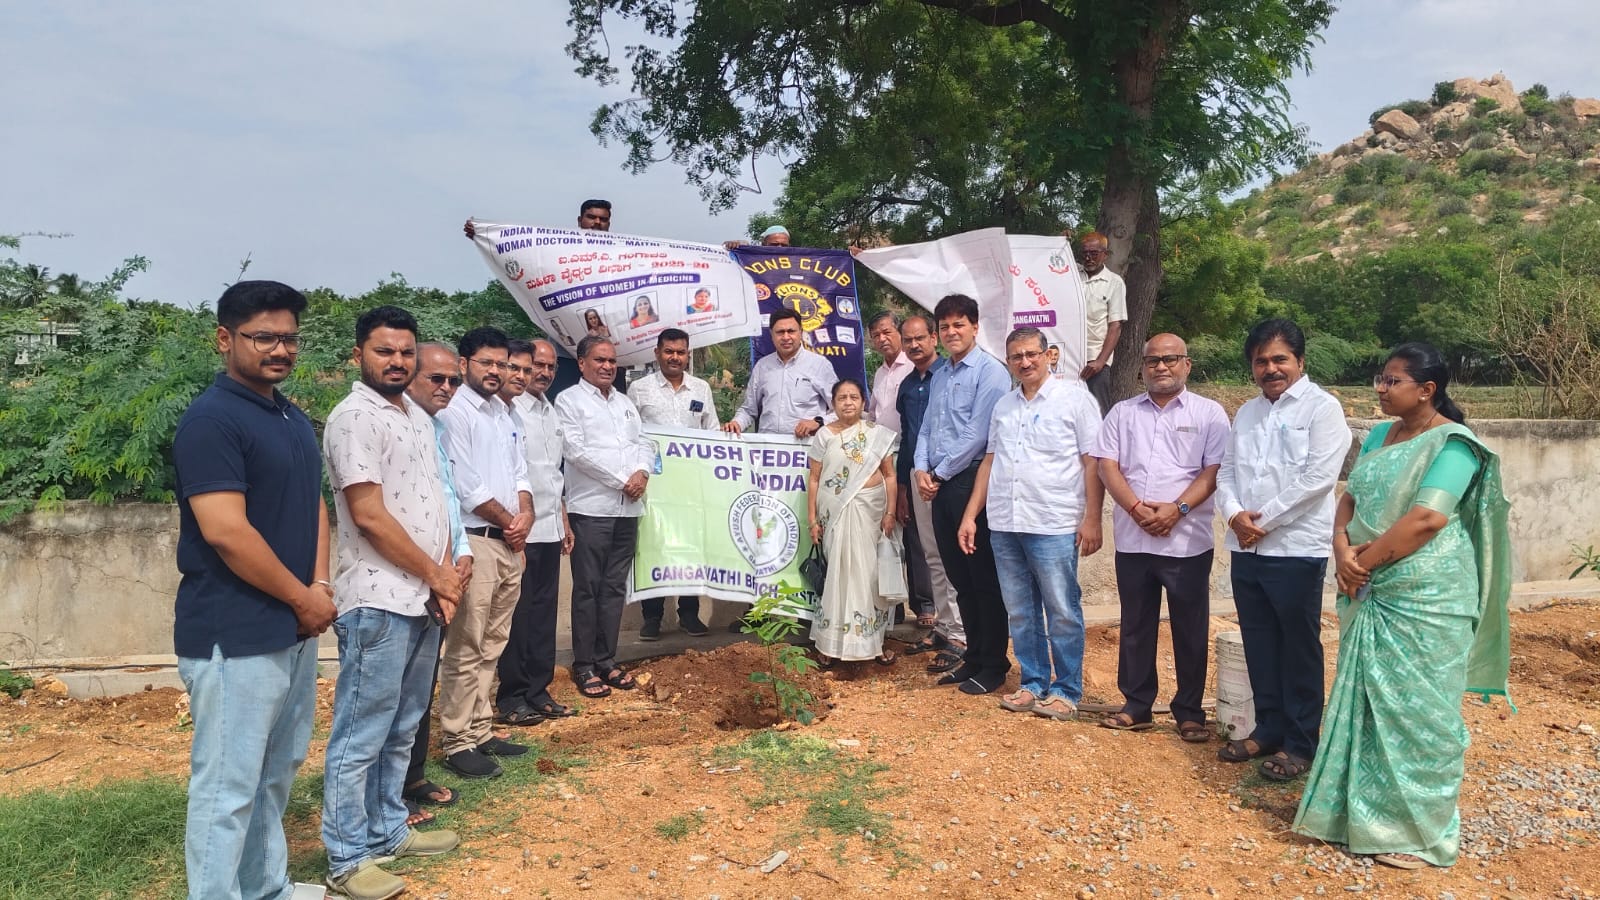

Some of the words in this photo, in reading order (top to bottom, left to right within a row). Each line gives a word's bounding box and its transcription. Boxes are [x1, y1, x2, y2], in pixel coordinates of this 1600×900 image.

[500, 227, 533, 238] INDIAN
[496, 238, 532, 255] WOMAN
[535, 237, 583, 246] DOCTORS
[744, 257, 792, 275] IONS
[800, 258, 851, 287] CLUB
[543, 298, 557, 308] THE
[556, 291, 583, 304] VISION
[585, 286, 598, 296] OF
[599, 280, 636, 294] WOMEN
[779, 285, 817, 299] LIONS
[666, 442, 744, 462] AYUSH
[714, 465, 743, 481] OF
[750, 469, 807, 492] INDIA
[732, 511, 744, 544] AYUSH
[780, 508, 793, 520] OF
[652, 565, 741, 586] GANGAVATHI
